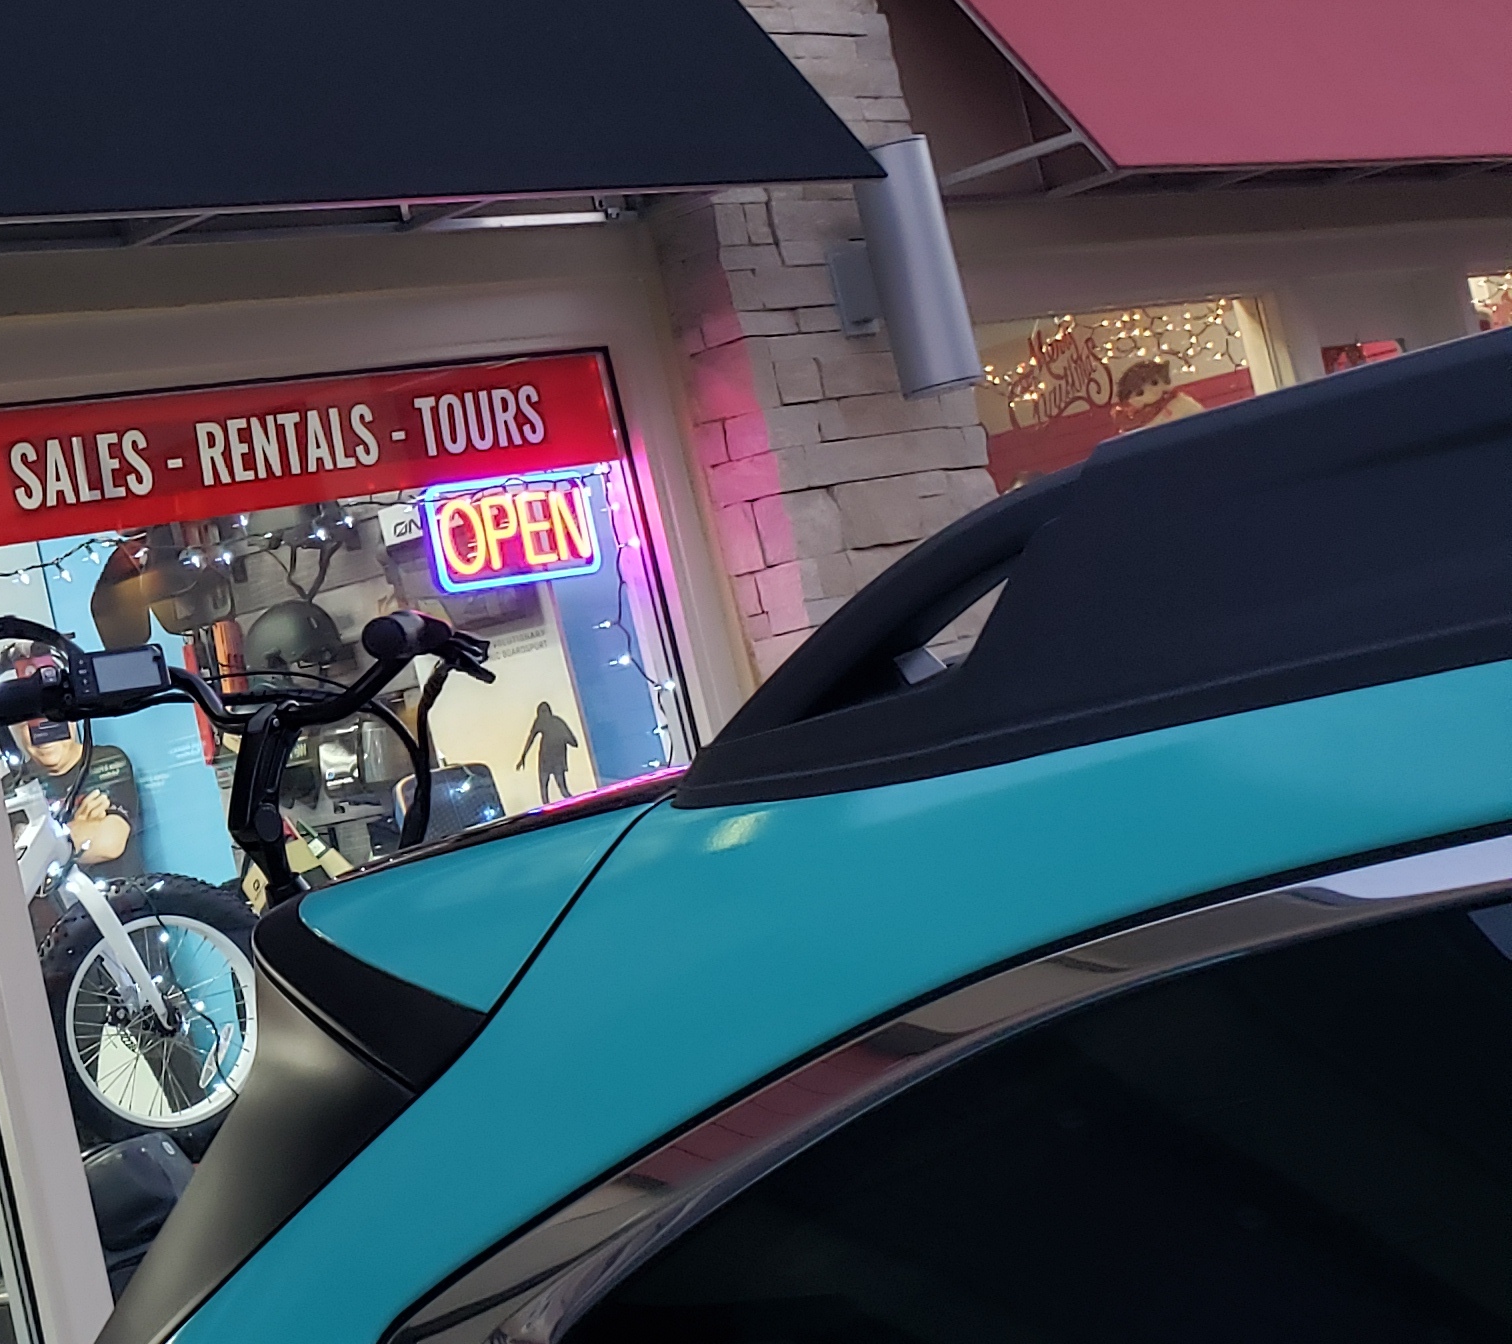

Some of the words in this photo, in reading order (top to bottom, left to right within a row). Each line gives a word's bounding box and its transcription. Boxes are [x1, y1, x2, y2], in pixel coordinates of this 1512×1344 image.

[9, 427, 155, 511] SALES
[194, 402, 380, 487] RENTALS
[413, 383, 545, 457] TOURS
[439, 486, 593, 575] OPEN
